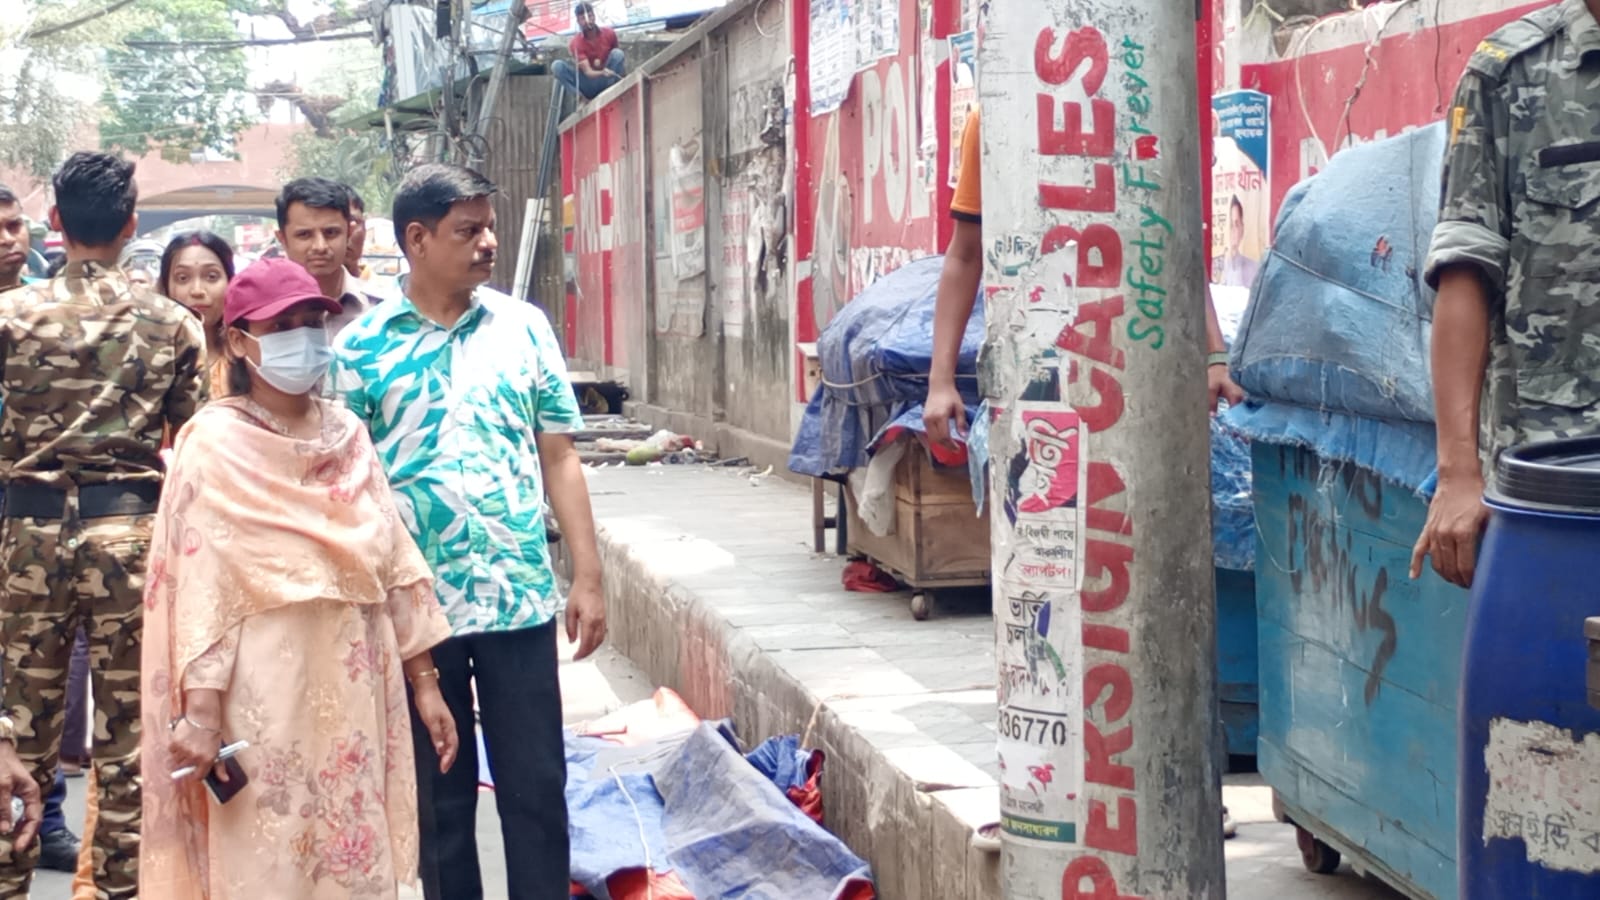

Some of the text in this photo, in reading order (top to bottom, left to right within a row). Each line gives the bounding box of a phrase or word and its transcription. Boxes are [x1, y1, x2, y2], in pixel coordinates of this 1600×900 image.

[1034, 25, 1126, 433] CABLES
[1121, 35, 1174, 350] Safety Frever
